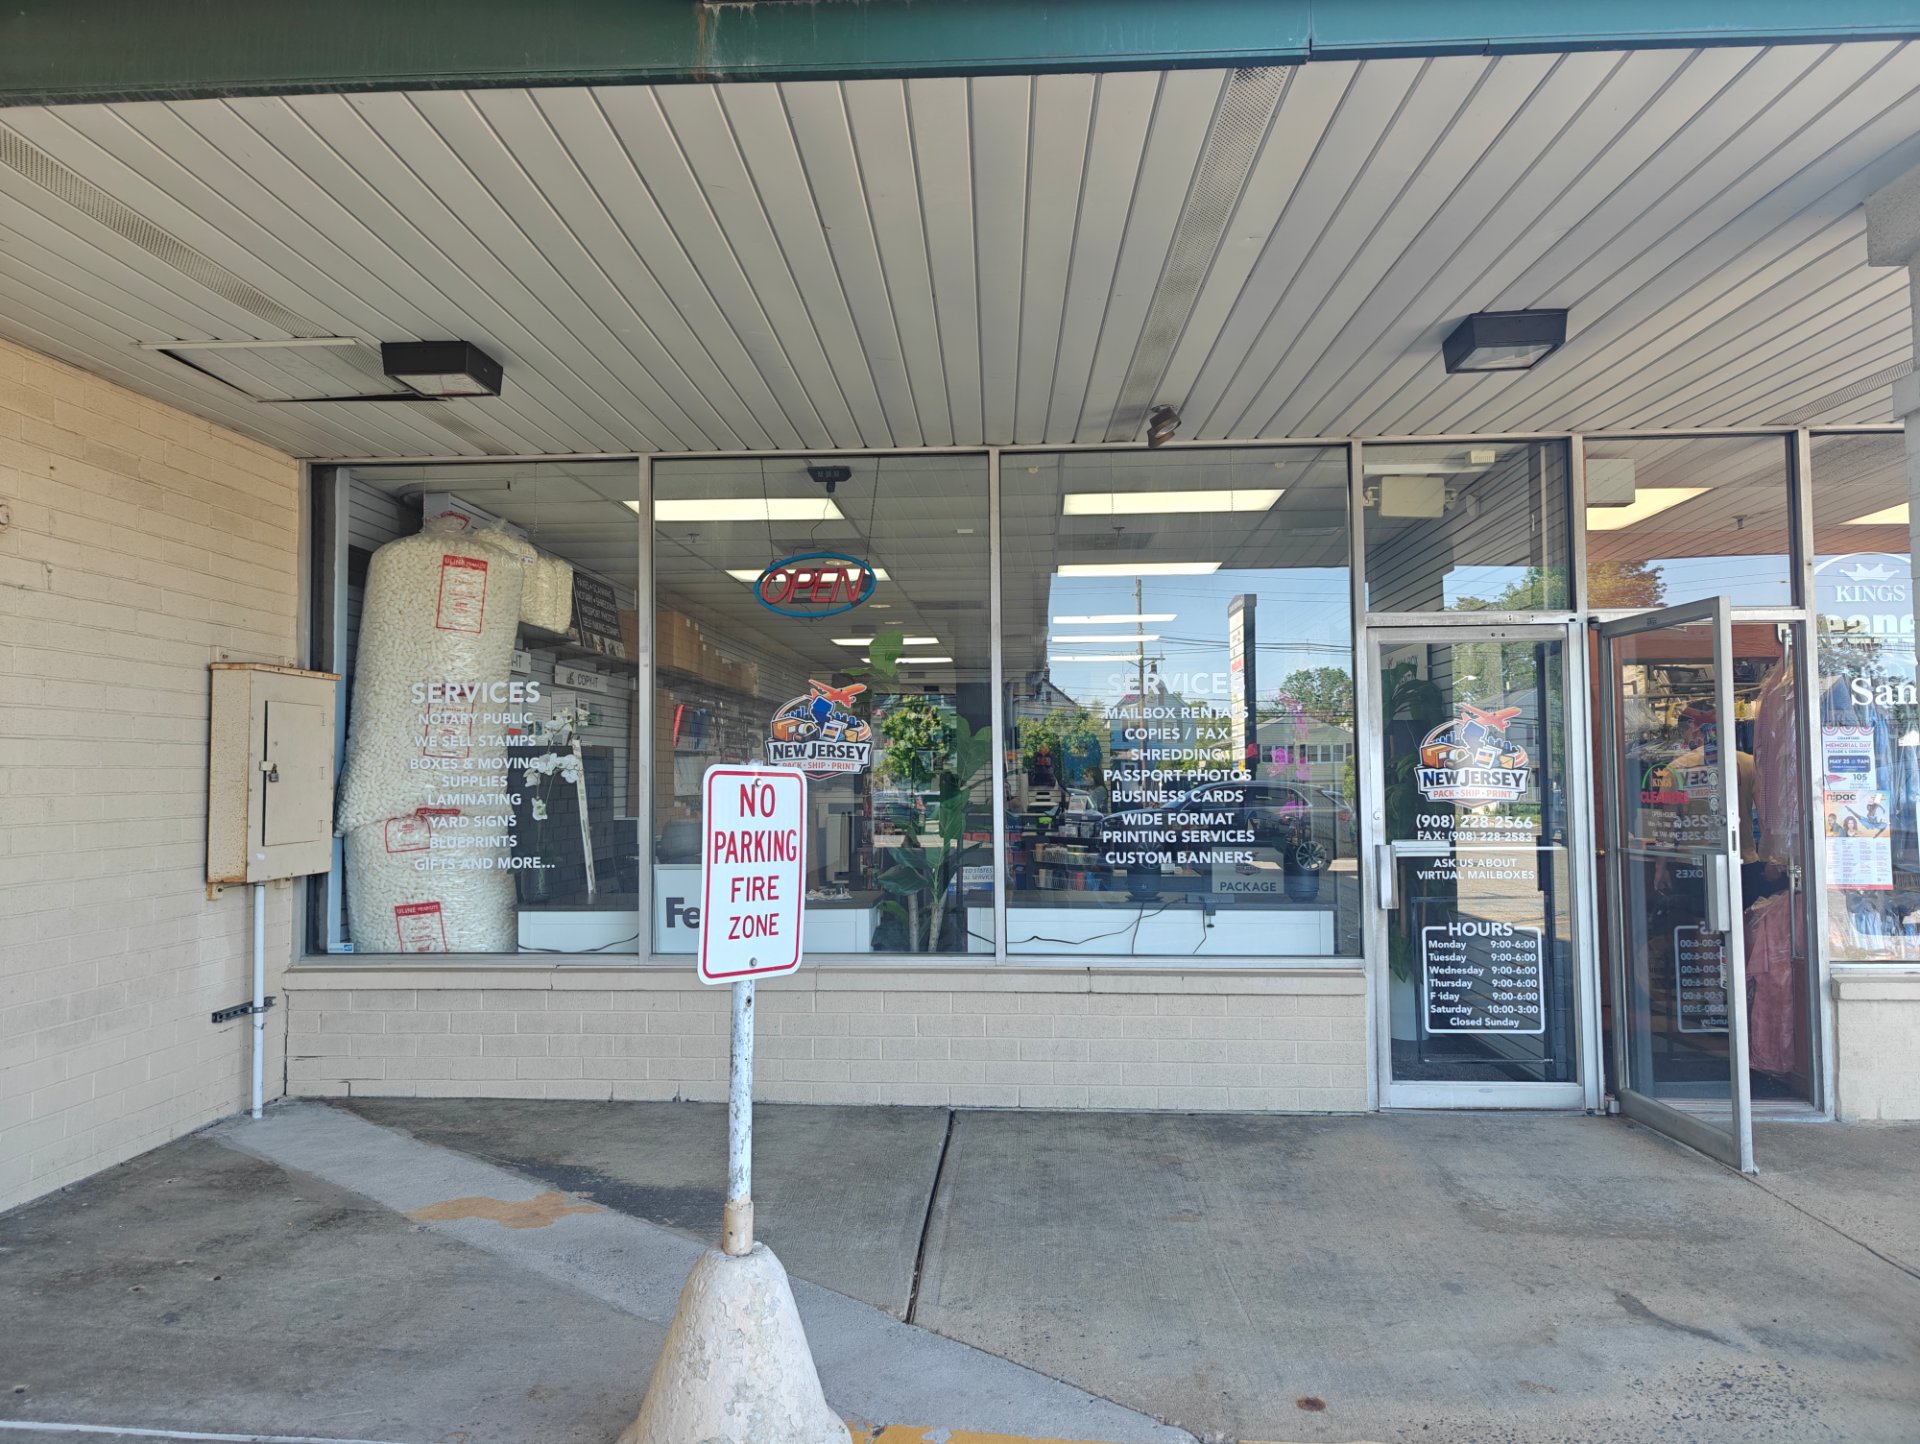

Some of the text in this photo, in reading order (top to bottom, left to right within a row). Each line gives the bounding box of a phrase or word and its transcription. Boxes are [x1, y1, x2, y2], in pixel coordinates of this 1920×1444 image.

[761, 567, 865, 604] OPEN
[1835, 585, 1906, 602] KINGS
[411, 681, 541, 705] SERVICES
[418, 712, 534, 725] NOTARY PUBLIC
[1104, 707, 1249, 720] MAILBOX RENTAS
[1125, 727, 1181, 740] COPIES
[1196, 727, 1228, 740] FAX
[415, 735, 536, 747] WE SELL STAMPS
[773, 743, 867, 760] NEW JERSEY
[1131, 749, 1224, 761] SHREDDING
[410, 757, 540, 770] BOXES & MOVING
[807, 761, 826, 769] SHIP
[831, 762, 855, 770] PRINT
[442, 775, 508, 787] SUPPLIES
[1103, 769, 1252, 782] PASSPORT PHOTOS
[1423, 770, 1524, 788] NEW JERSEY
[1853, 773, 1868, 781] 105
[428, 793, 522, 806] LAMINATING
[739, 783, 776, 817] NO
[1112, 790, 1244, 803] BUSINESS CARDS
[1433, 790, 1512, 798] PACK SHIP PRINT
[429, 815, 469, 828] YARD
[474, 814, 517, 827] SIGNS
[1122, 812, 1235, 826] WIDE FORMAT
[1416, 814, 1455, 829] (908)
[430, 835, 518, 849] BLUEPRINTS
[1102, 830, 1255, 843] PRINTING SERVICES
[1417, 830, 1532, 842] FAX: (908) 228-2583
[714, 829, 797, 864] PARKING
[414, 857, 556, 871] GIFTS AND MORE...
[1105, 851, 1253, 865] CUSTOM BANNERS
[1433, 858, 1517, 868] ASK US ABOUT
[1416, 870, 1535, 880] VIRTUAL MAILBOXES
[731, 875, 780, 903] FIRE
[1220, 881, 1277, 892] PACKAGE
[666, 896, 700, 929] Fe
[728, 913, 780, 940] ZONE
[1448, 922, 1513, 936] HOURS
[1428, 940, 1536, 950] Monday 9:00-6:00
[1428, 953, 1536, 963] Tuesday 9:00-6:00
[1429, 966, 1537, 976] Wednesday 9:00-6:00
[1429, 979, 1537, 989] Thursday 9:00-6:00
[1430, 992, 1538, 1002] Fiday 9:00-6:00
[1430, 1005, 1538, 1015] Saturday 10:00-3:00
[1450, 1018, 1520, 1028] Closed Sunday
